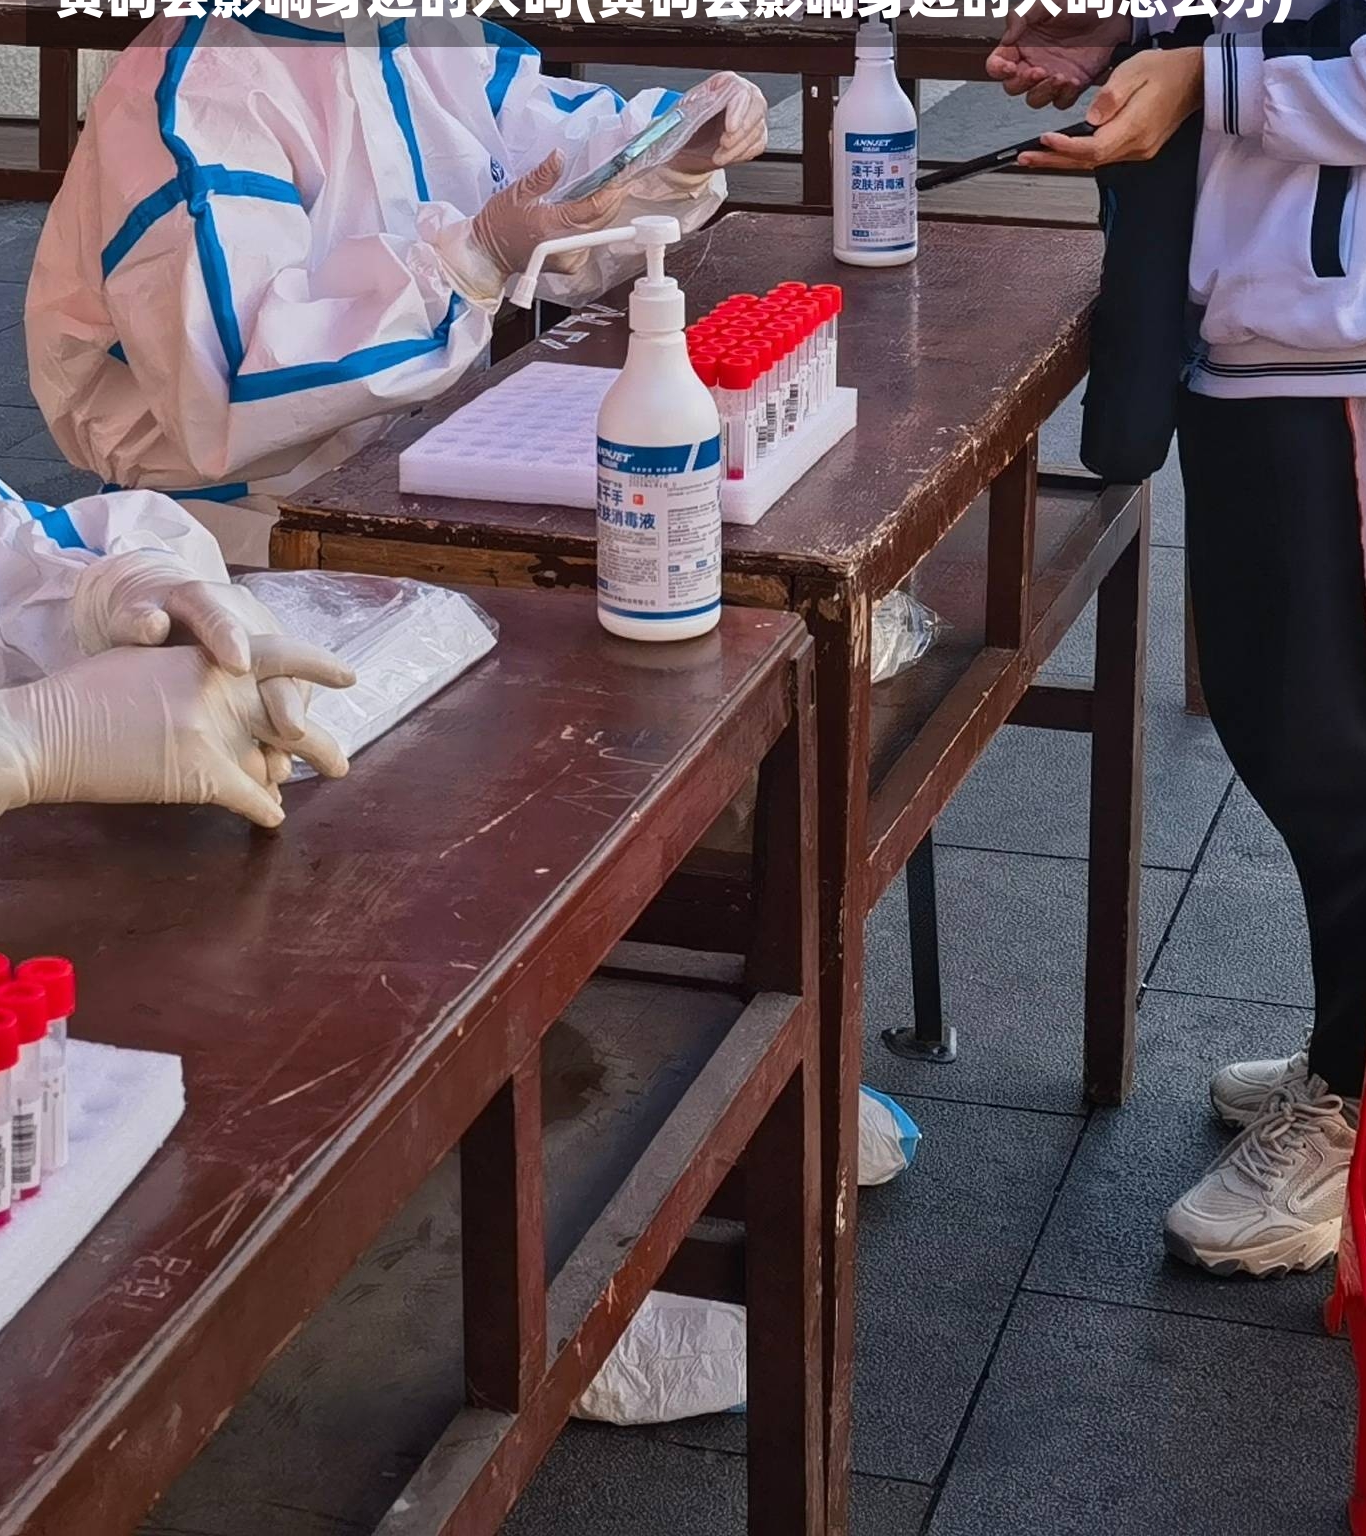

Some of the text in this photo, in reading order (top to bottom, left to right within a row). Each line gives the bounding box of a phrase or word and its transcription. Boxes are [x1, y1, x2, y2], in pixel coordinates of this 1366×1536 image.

[853, 138, 892, 147] ANNJET
[851, 165, 884, 177] 速干手
[851, 177, 904, 191] 皮肤消毒液
